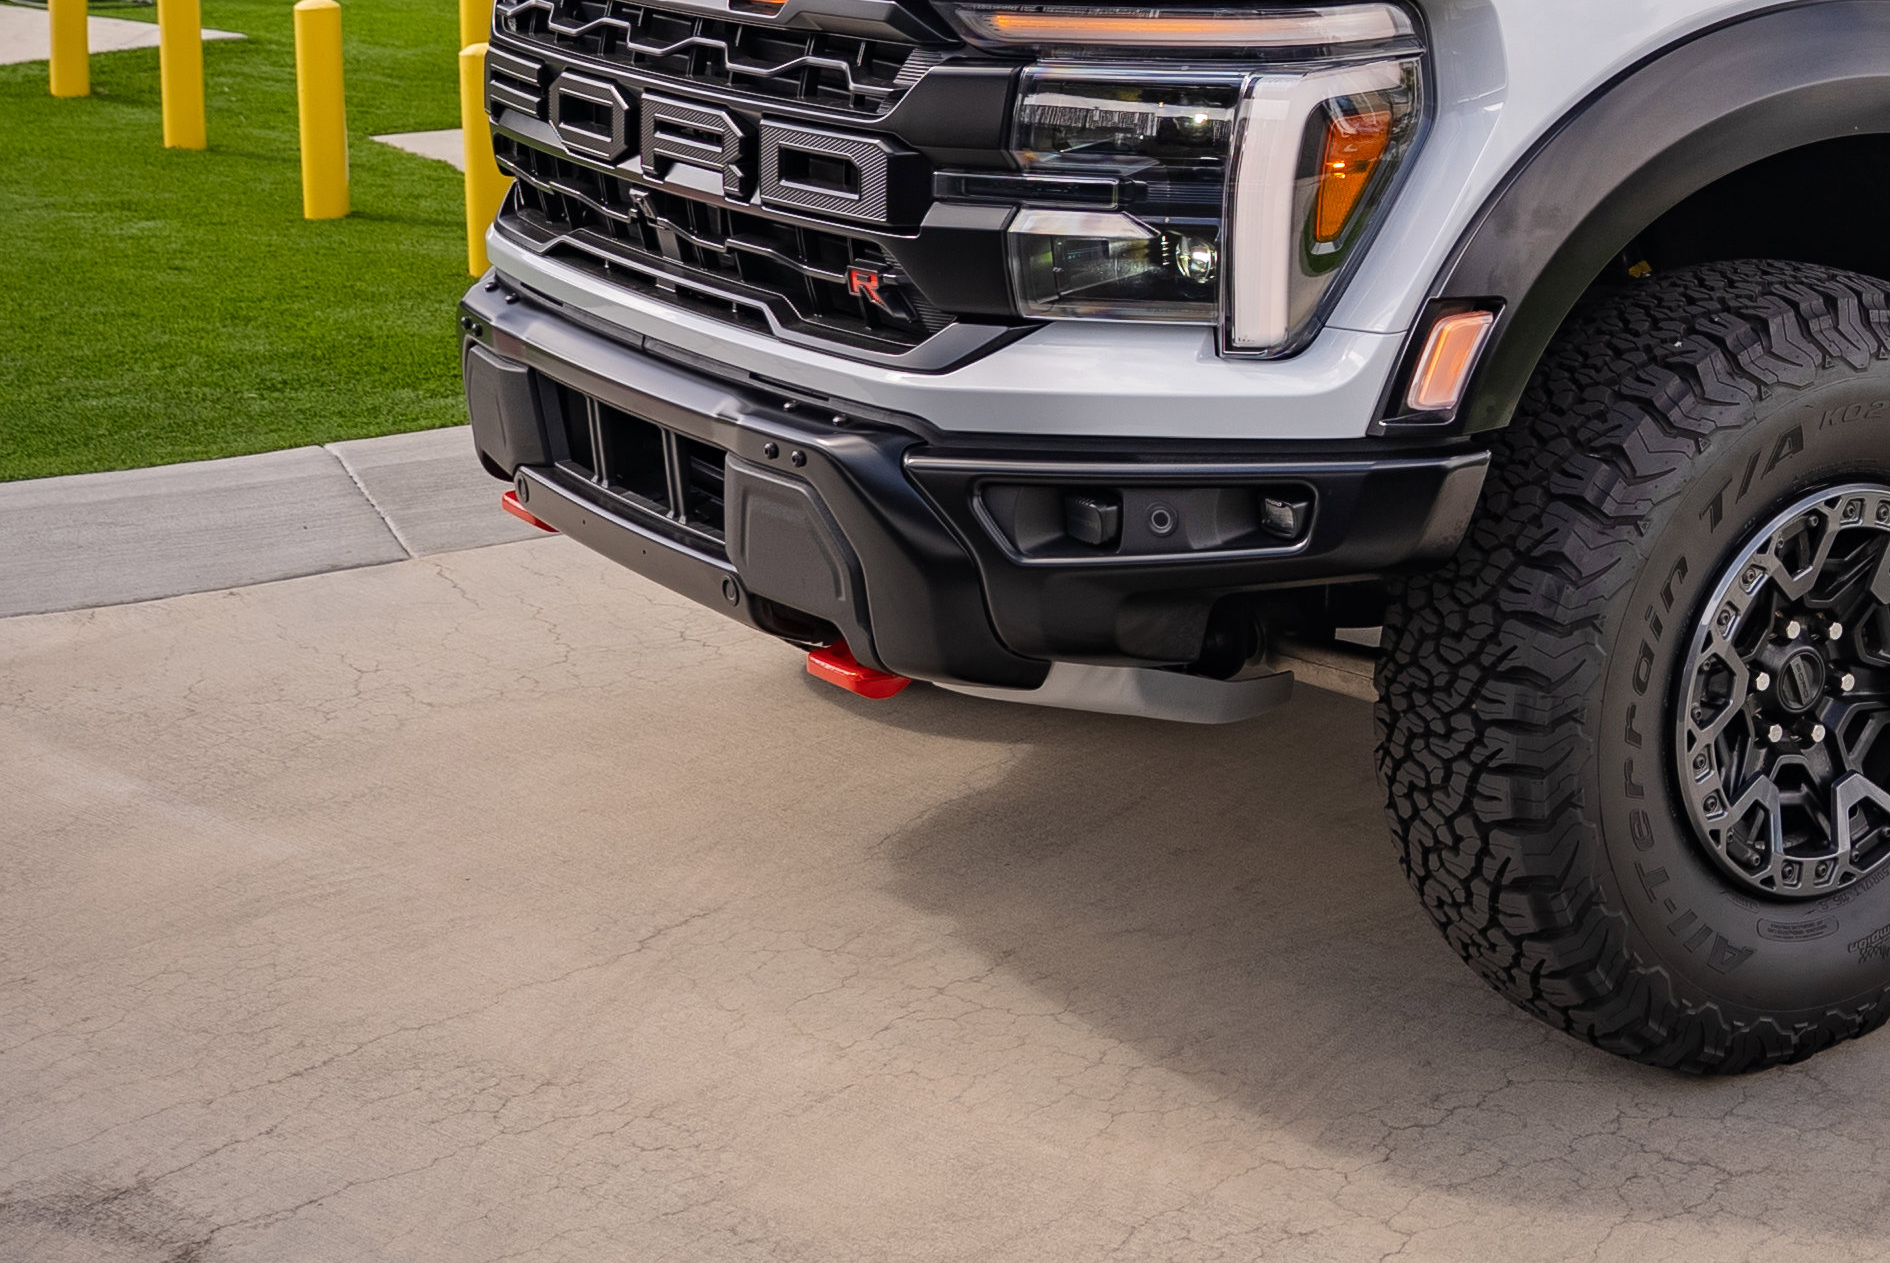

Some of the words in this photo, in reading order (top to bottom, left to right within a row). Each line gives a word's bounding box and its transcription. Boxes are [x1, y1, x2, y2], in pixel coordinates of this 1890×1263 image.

[487, 50, 890, 223] FORD
[1623, 554, 1758, 976] All-Terrain
[1699, 424, 1804, 534] T/A
